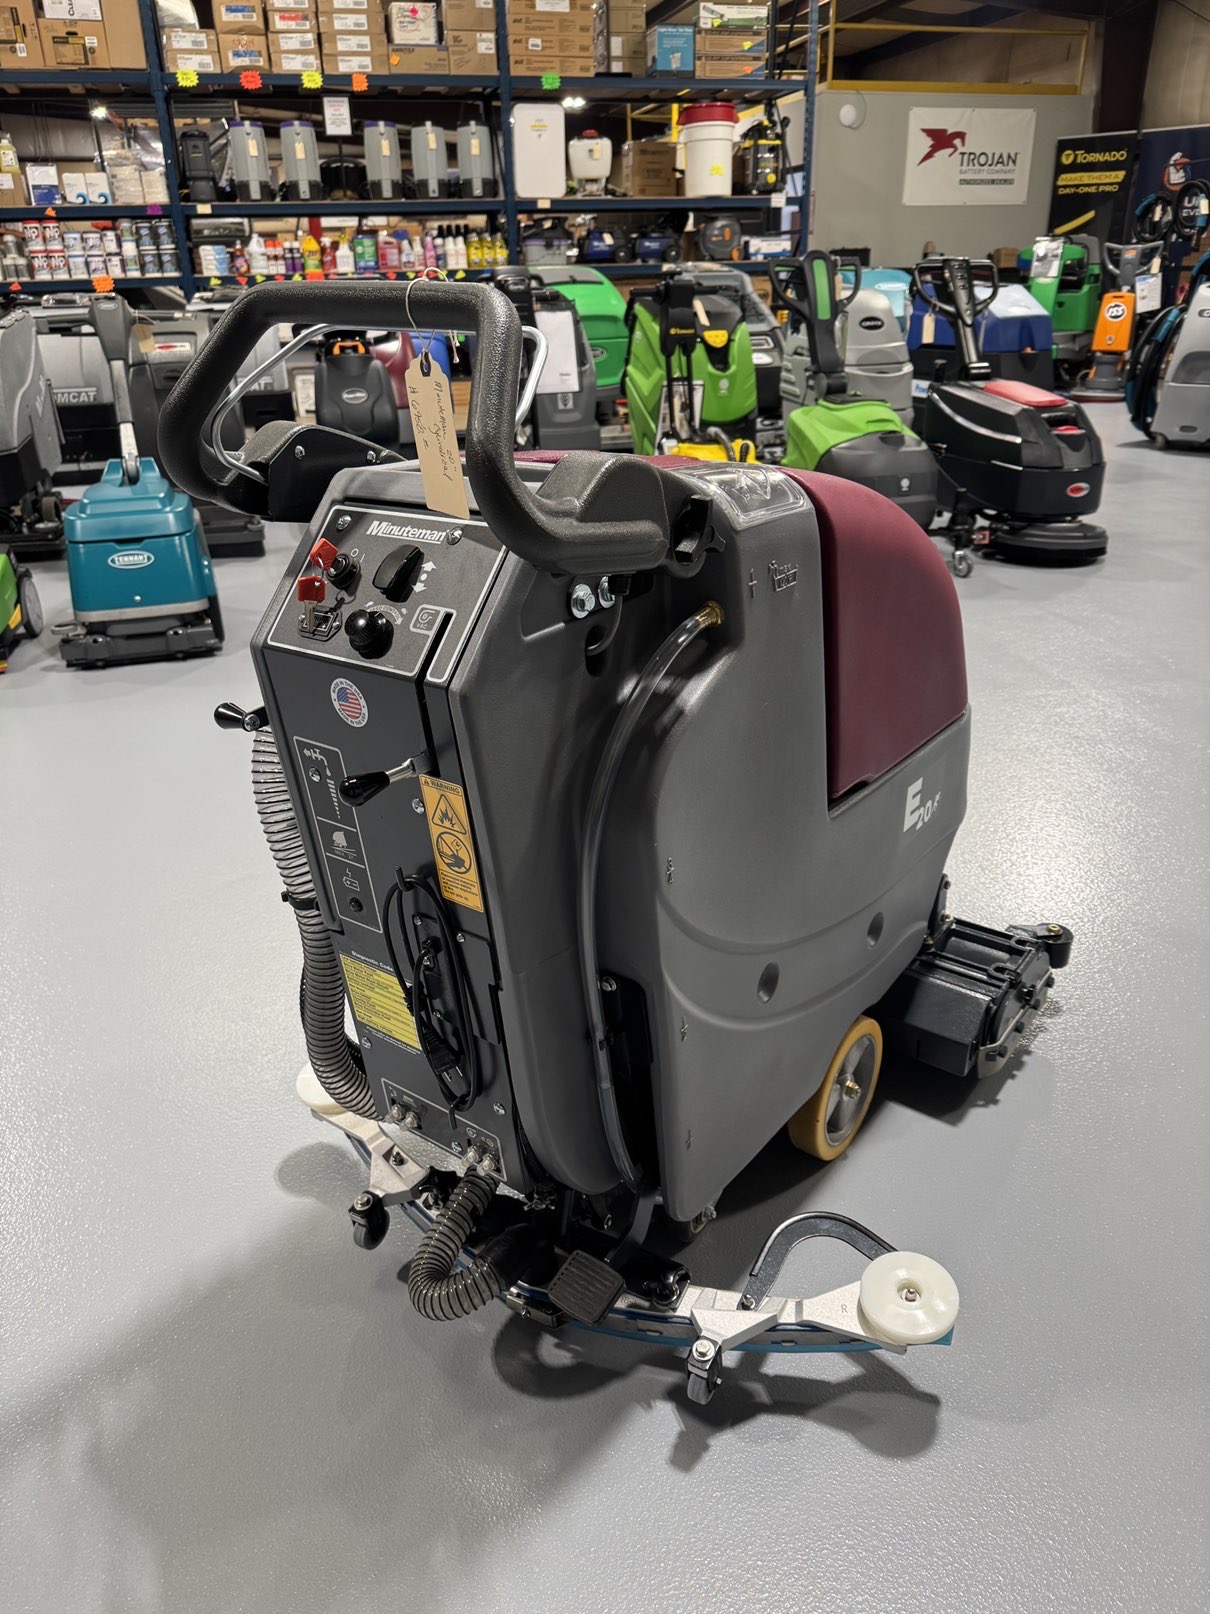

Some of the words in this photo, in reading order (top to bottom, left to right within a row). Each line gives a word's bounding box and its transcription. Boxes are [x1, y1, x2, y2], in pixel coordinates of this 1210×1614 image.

[959, 152, 1018, 167] TROJAN
[1075, 150, 1128, 163] TORNADO
[1058, 186, 1098, 195] DAY-ONE
[1099, 184, 1119, 192] PRO
[54, 391, 97, 404] MCAT
[366, 520, 446, 543] Minuteman
[431, 780, 461, 794] WARNING
[351, 950, 379, 966] Diagnostic
[840, 1303, 849, 1314] R
